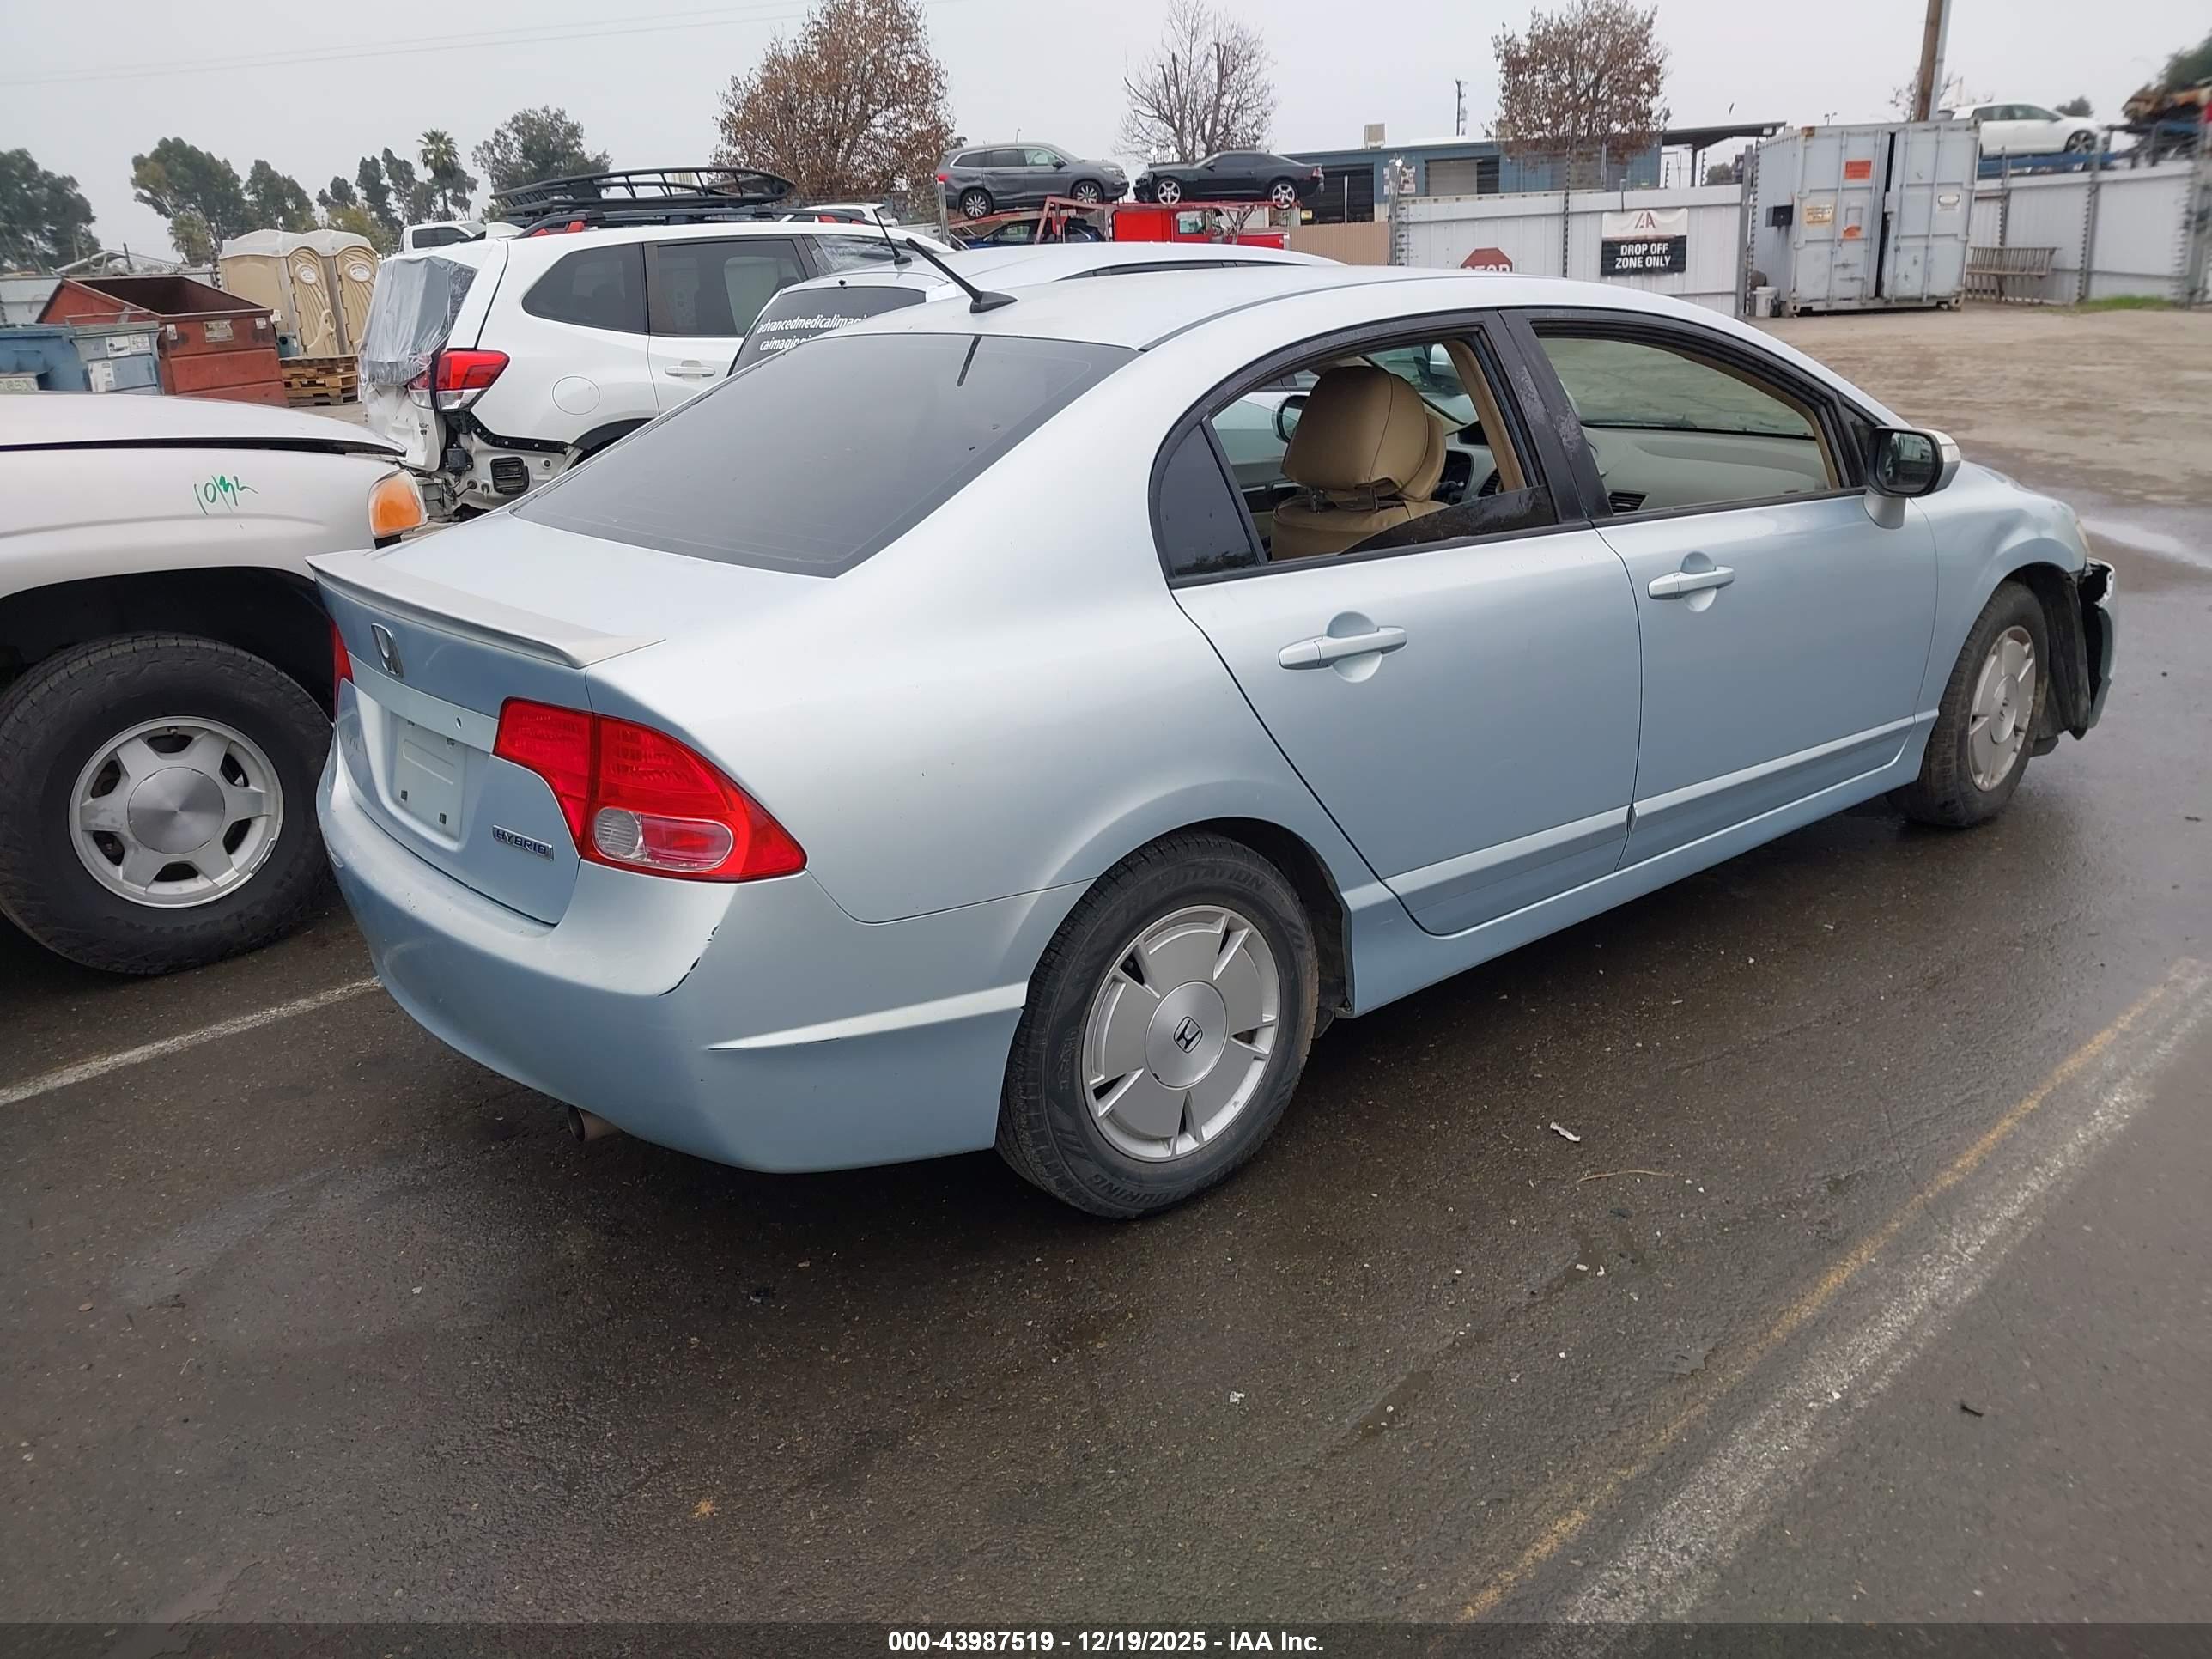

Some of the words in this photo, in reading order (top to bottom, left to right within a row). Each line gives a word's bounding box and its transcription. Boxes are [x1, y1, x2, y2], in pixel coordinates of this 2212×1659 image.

[1620, 244, 1648, 256] DROP
[1650, 243, 1668, 254] OFF
[1615, 257, 1643, 269] ZONE
[1645, 255, 1671, 267] ONLY
[495, 830, 547, 855] HYBRID
